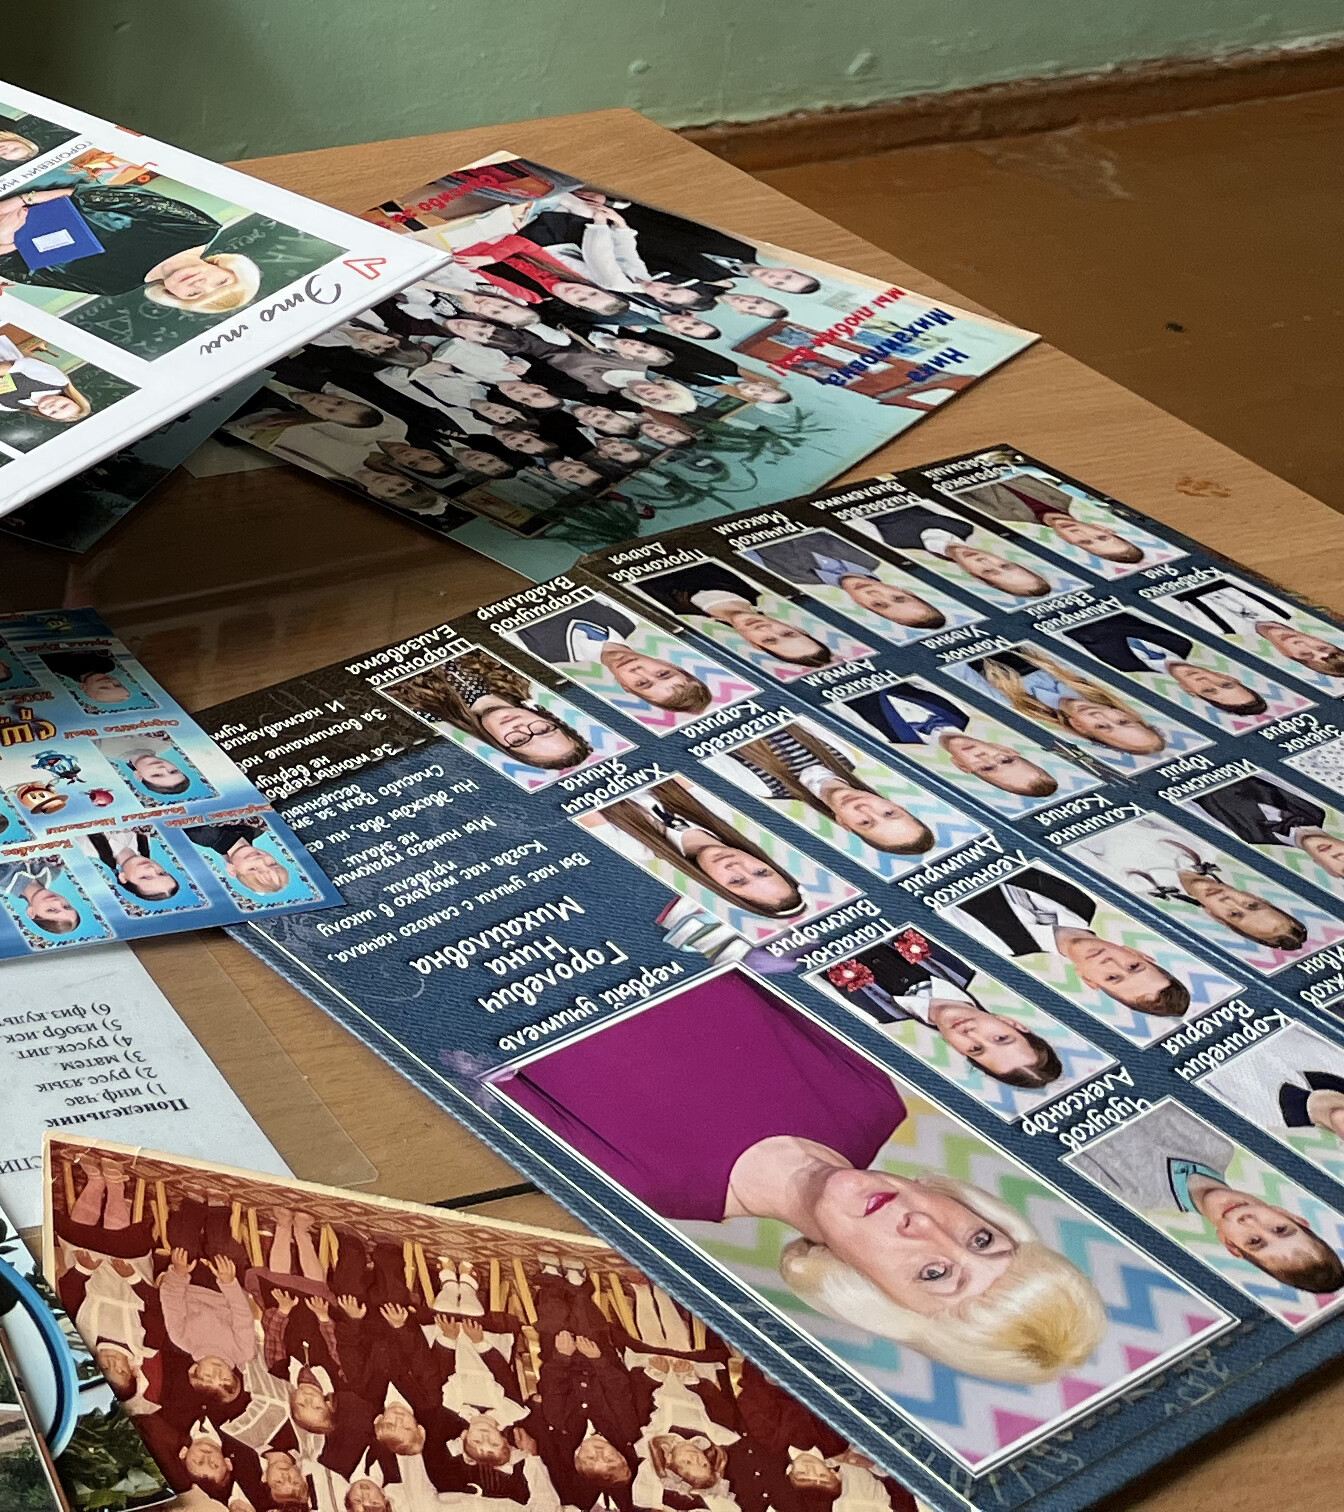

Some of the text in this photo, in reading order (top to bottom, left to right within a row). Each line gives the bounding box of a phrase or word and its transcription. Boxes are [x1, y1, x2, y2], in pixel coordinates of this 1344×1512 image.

[260, 274, 341, 321] Это
[410, 896, 585, 982] Михайловна
[484, 936, 567, 975] Нина
[478, 941, 628, 1013] Горолевич
[9, 1033, 107, 1063] русск.лит.
[52, 1051, 118, 1074] матем.
[35, 1068, 129, 1092] русс.язык
[65, 1087, 142, 1106] инф.час
[45, 1099, 190, 1127] Понедельник
